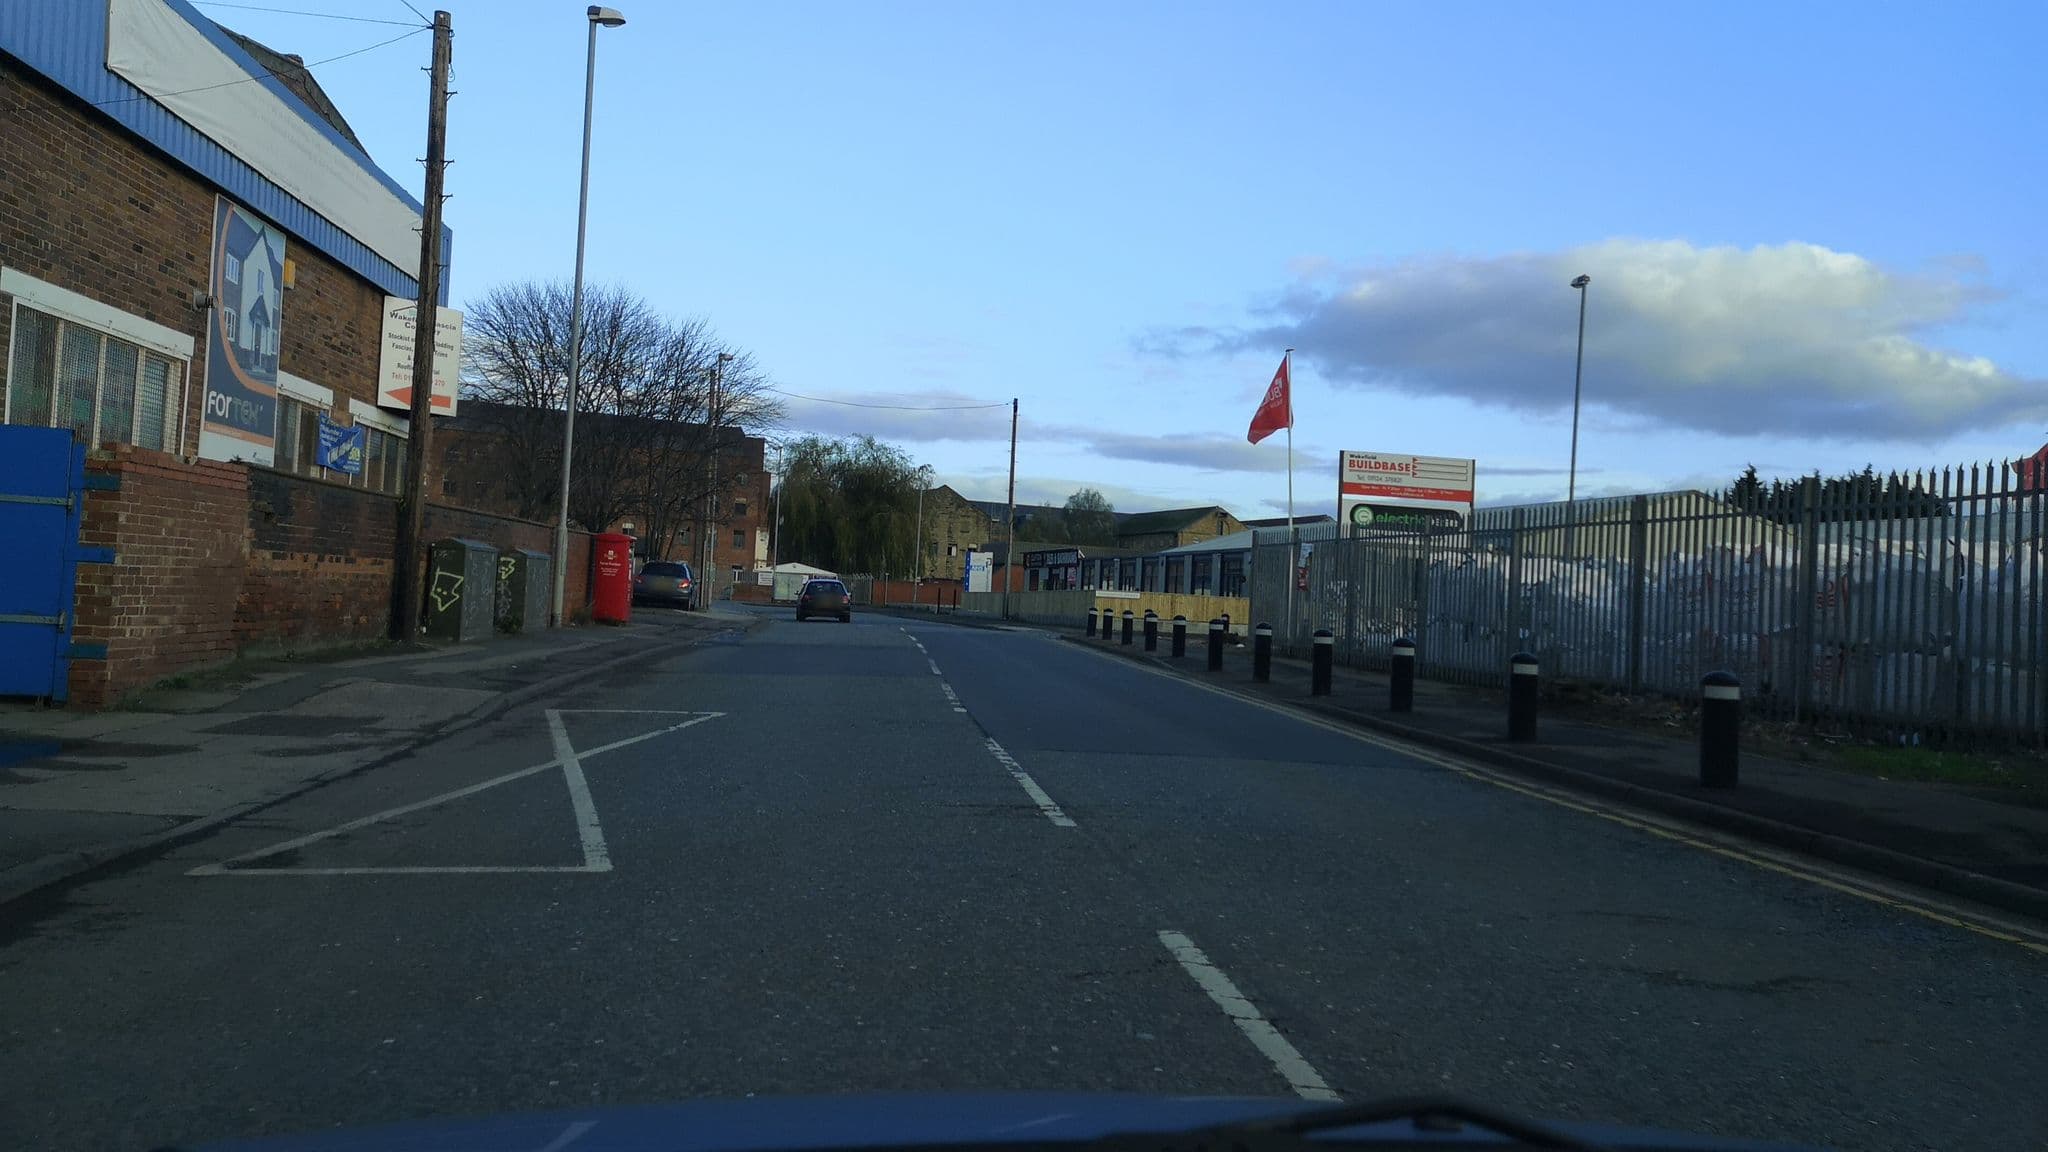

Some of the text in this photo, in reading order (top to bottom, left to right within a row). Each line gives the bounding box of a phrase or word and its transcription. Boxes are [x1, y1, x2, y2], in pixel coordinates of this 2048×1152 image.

[389, 312, 416, 321] Wakef
[436, 322, 456, 330] ascia
[1349, 459, 1412, 472] BUILDBASE
